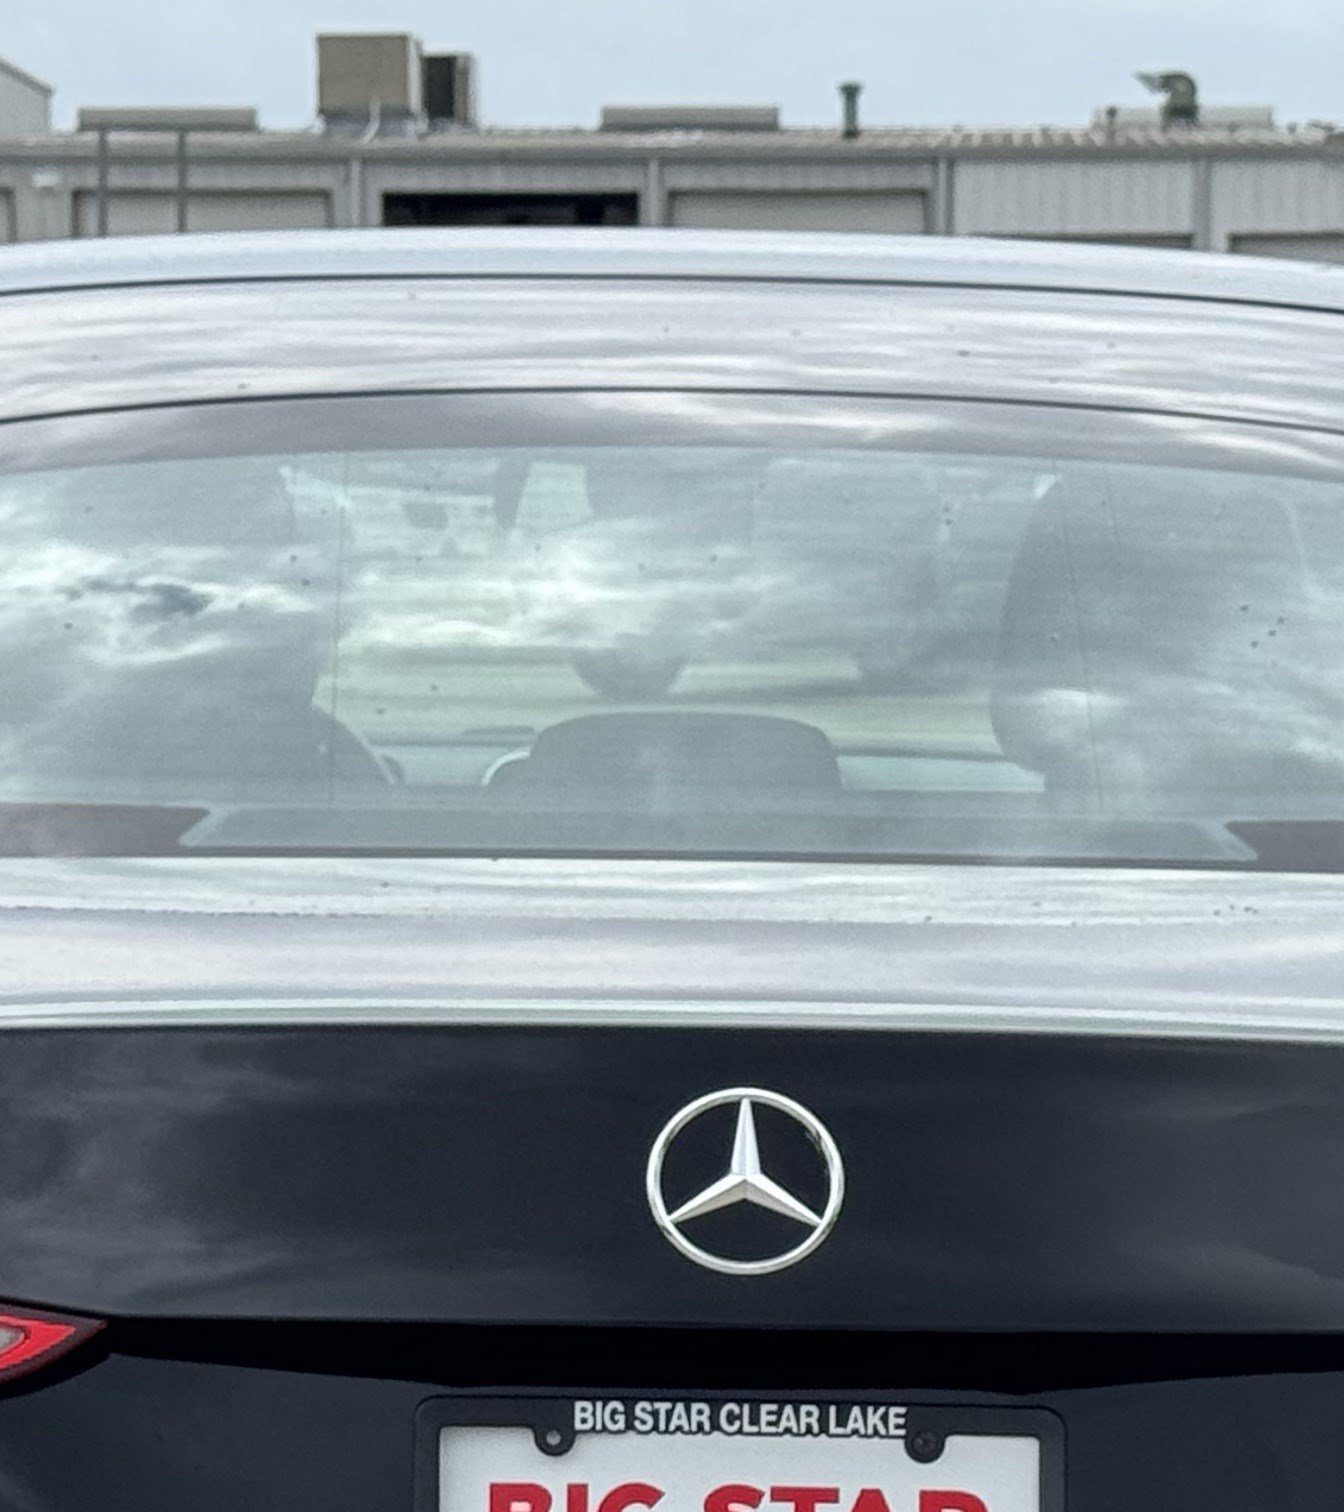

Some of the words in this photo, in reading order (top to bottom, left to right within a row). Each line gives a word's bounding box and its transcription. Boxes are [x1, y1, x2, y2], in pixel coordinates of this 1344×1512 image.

[574, 1402, 627, 1431] BIG
[633, 1404, 713, 1435] STAR
[719, 1405, 821, 1436] CLEAR
[827, 1406, 907, 1436] LAKE
